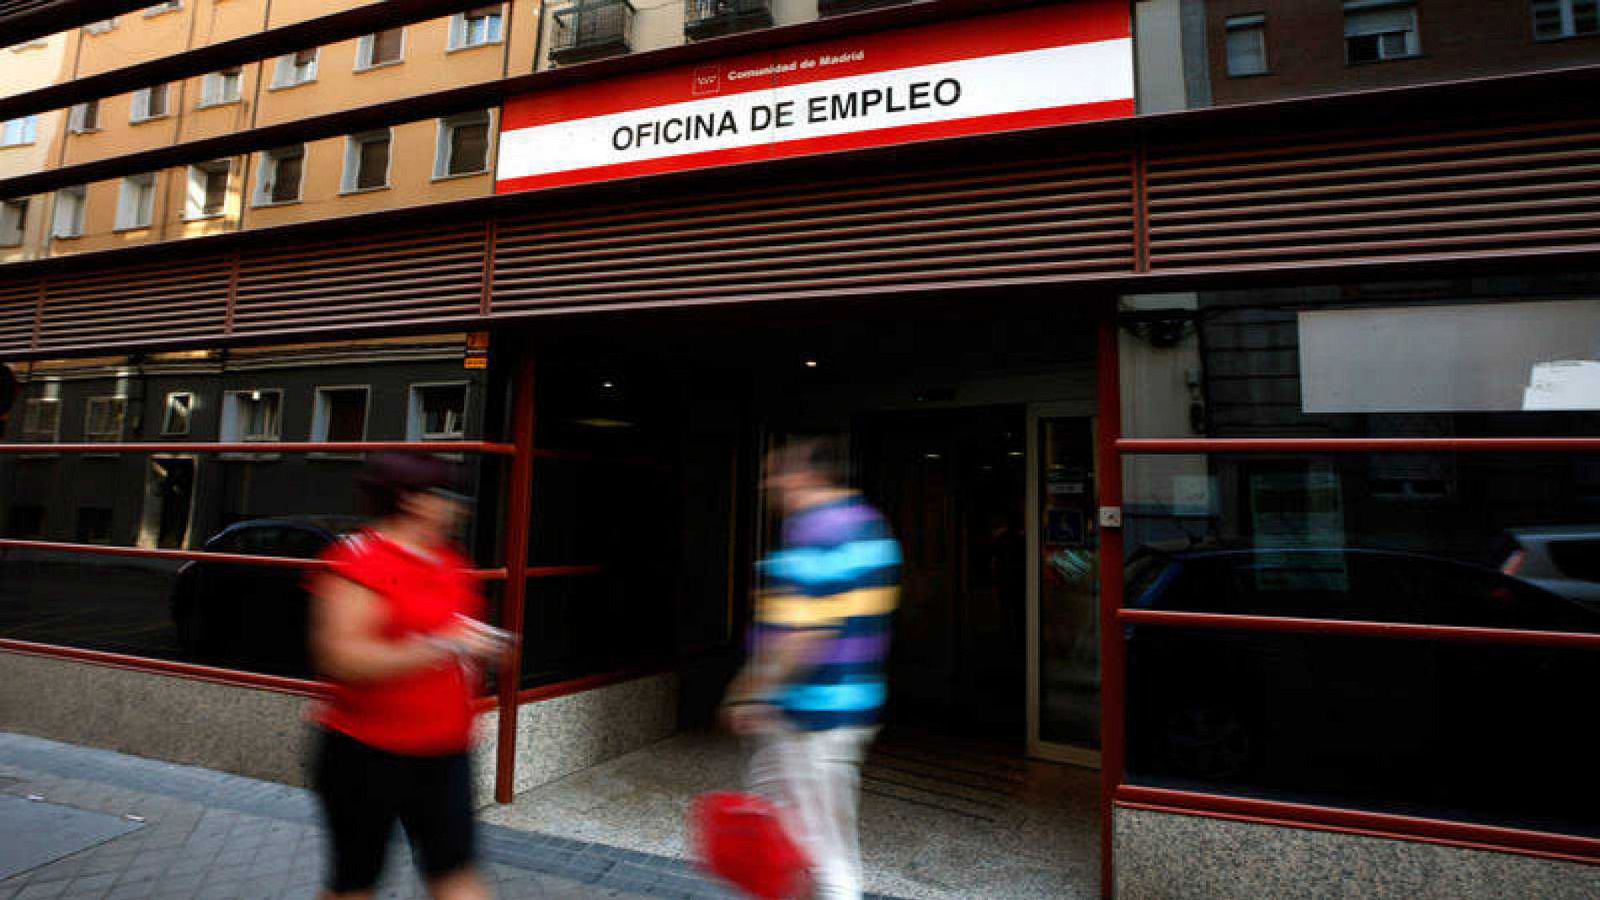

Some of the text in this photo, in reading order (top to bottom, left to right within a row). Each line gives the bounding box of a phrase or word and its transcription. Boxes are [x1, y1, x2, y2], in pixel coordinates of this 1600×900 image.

[727, 50, 865, 81] Comunidad de Madrid
[612, 77, 962, 151] OFICINA DE EMPLEO
